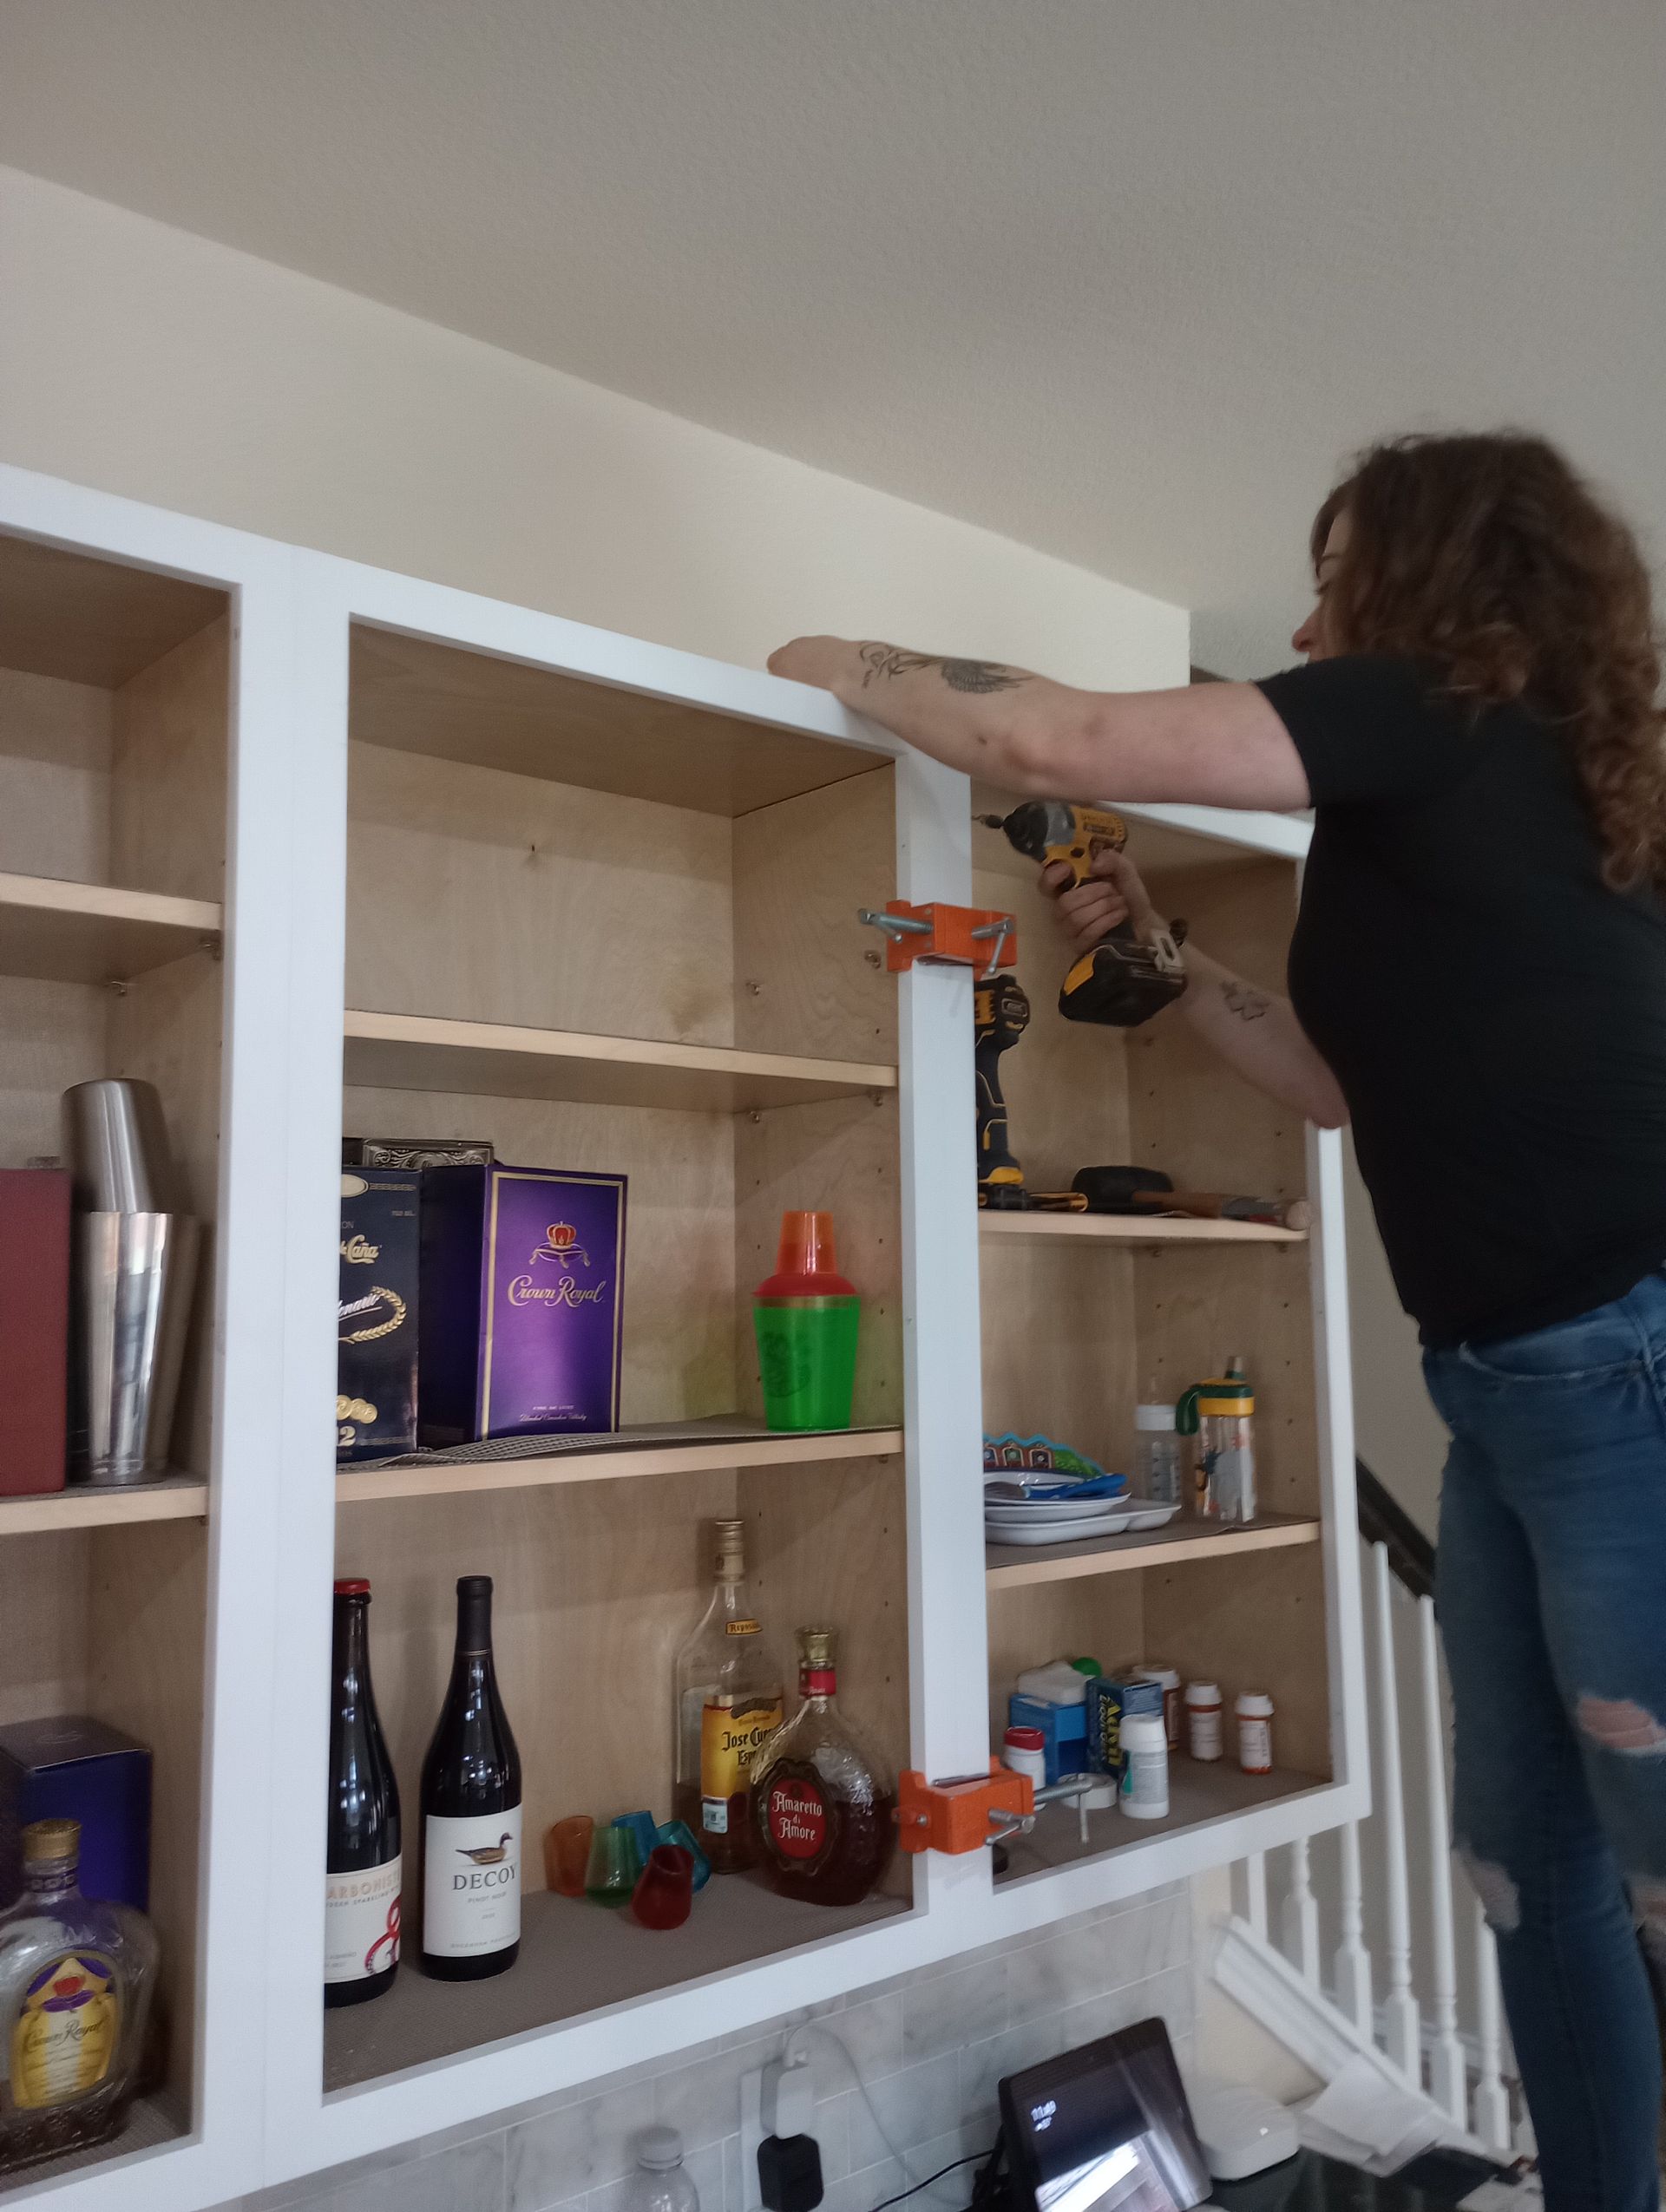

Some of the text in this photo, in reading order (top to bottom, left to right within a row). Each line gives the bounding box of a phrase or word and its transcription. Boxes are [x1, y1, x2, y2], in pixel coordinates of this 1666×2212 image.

[341, 1221, 354, 1229] ON
[346, 1234, 380, 1264] Caña
[508, 1274, 607, 1307] Crown Royal
[337, 1425, 357, 1447] 2
[721, 1731, 749, 1751] Jose
[772, 1791, 823, 1817] Amaretto
[777, 1816, 817, 1841] Amore
[792, 1814, 801, 1824] di
